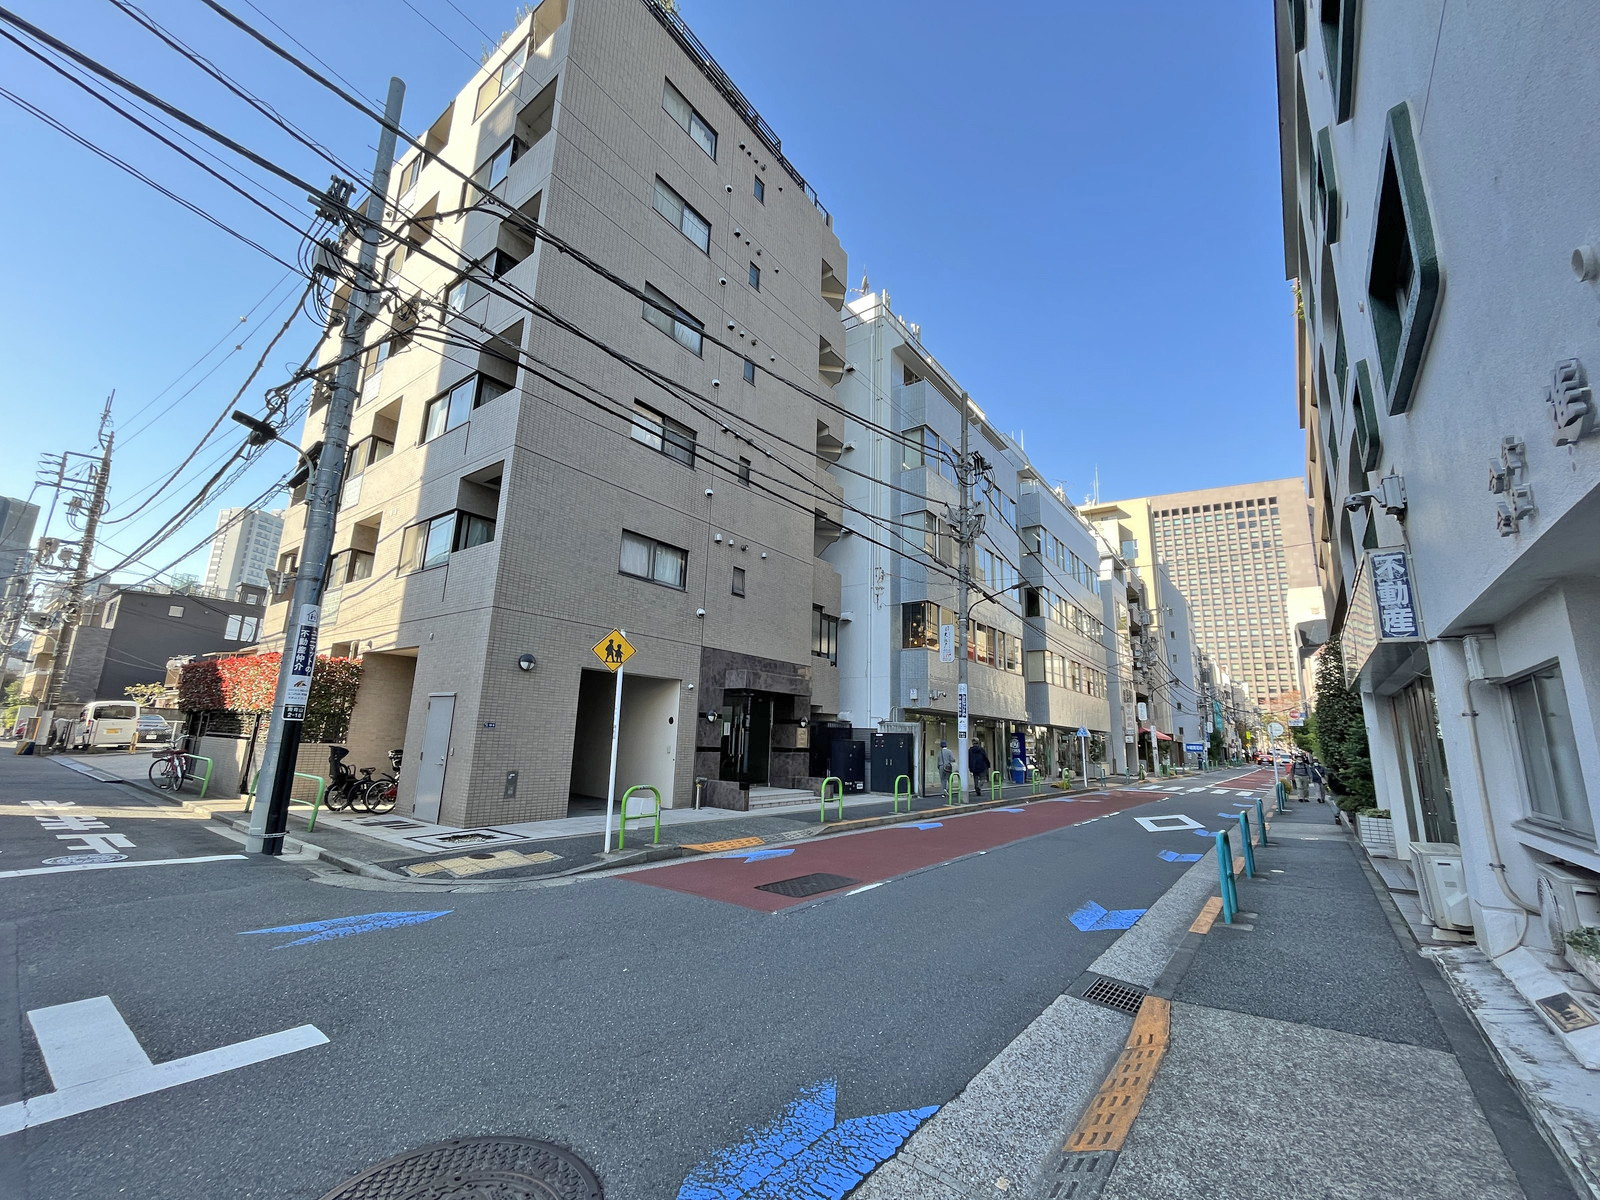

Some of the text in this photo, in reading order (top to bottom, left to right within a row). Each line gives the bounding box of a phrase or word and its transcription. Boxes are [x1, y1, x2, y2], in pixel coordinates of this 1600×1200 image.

[1373, 554, 1416, 633] 不動産
[294, 629, 310, 671] 不動産仲介
